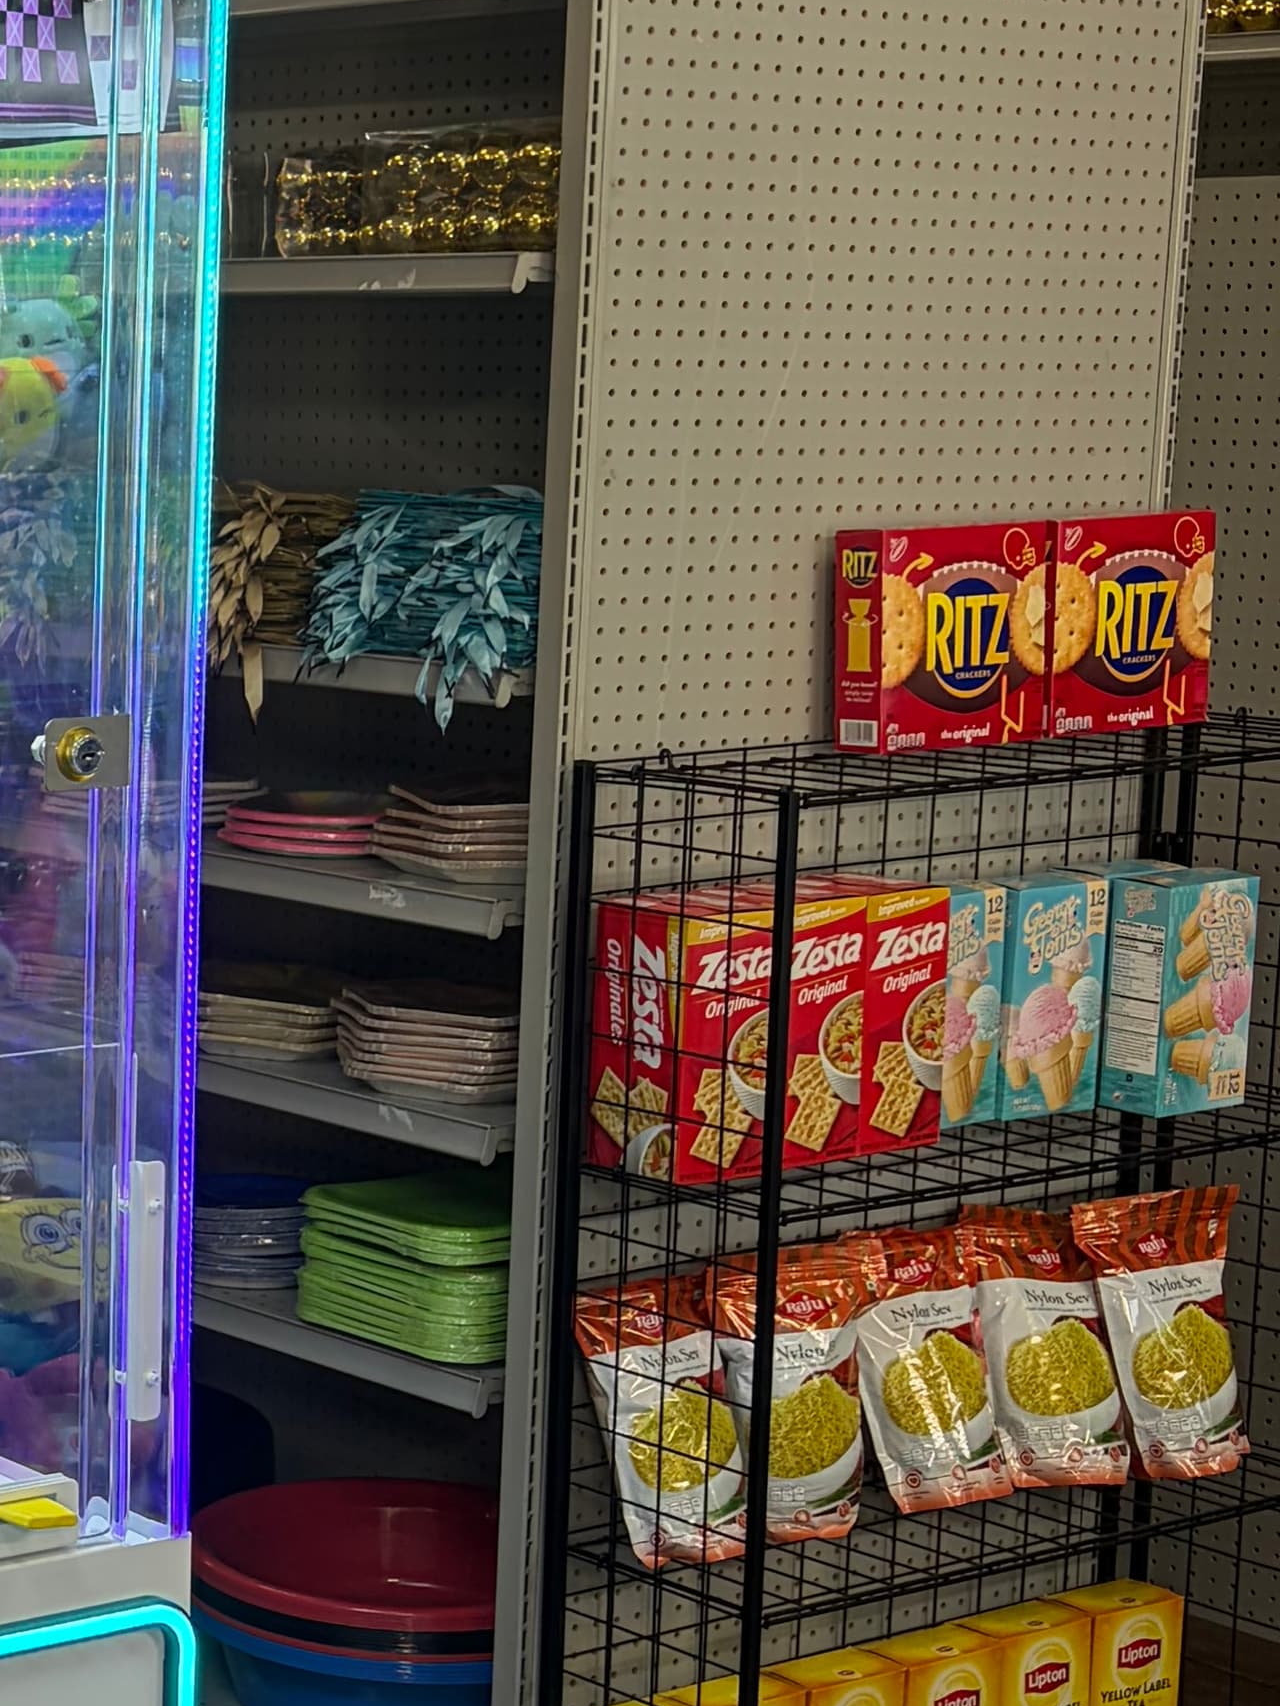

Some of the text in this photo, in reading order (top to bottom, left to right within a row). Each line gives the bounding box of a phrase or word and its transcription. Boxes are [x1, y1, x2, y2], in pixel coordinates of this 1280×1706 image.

[842, 550, 878, 579] RITZ
[1095, 580, 1180, 660] RITZ
[926, 592, 1011, 675] RITZ
[1122, 654, 1157, 665] CRACKERS
[955, 669, 991, 681] CRACKERS
[1107, 705, 1154, 726] the original
[941, 722, 990, 743] the original
[878, 897, 915, 917] Improved
[986, 895, 1003, 916] 12
[1090, 889, 1106, 909] 12
[794, 906, 831, 927] mproved
[791, 932, 863, 981] Zesta
[870, 921, 947, 972] Zesta
[691, 947, 774, 995] Zesta
[883, 964, 932, 993] Original
[631, 933, 667, 1069] Zesta
[798, 975, 848, 1005] Original
[705, 990, 761, 1019] Original
[1227, 1072, 1241, 1094] 12
[1139, 1233, 1167, 1257] Raju
[1028, 1249, 1060, 1270] Raju
[894, 1259, 932, 1284] Raju
[1148, 1275, 1203, 1296] Nylon Sev
[786, 1295, 827, 1321] Raju
[1025, 1289, 1089, 1307] Nylon Sev
[890, 1302, 952, 1324] Nylon Sev
[641, 1349, 680, 1372] Nyon
[776, 1343, 827, 1363] Nylon
[1121, 1643, 1159, 1664] Lipton
[1028, 1667, 1067, 1690] Lipton
[1100, 1677, 1172, 1704] YELLOW LABEL
